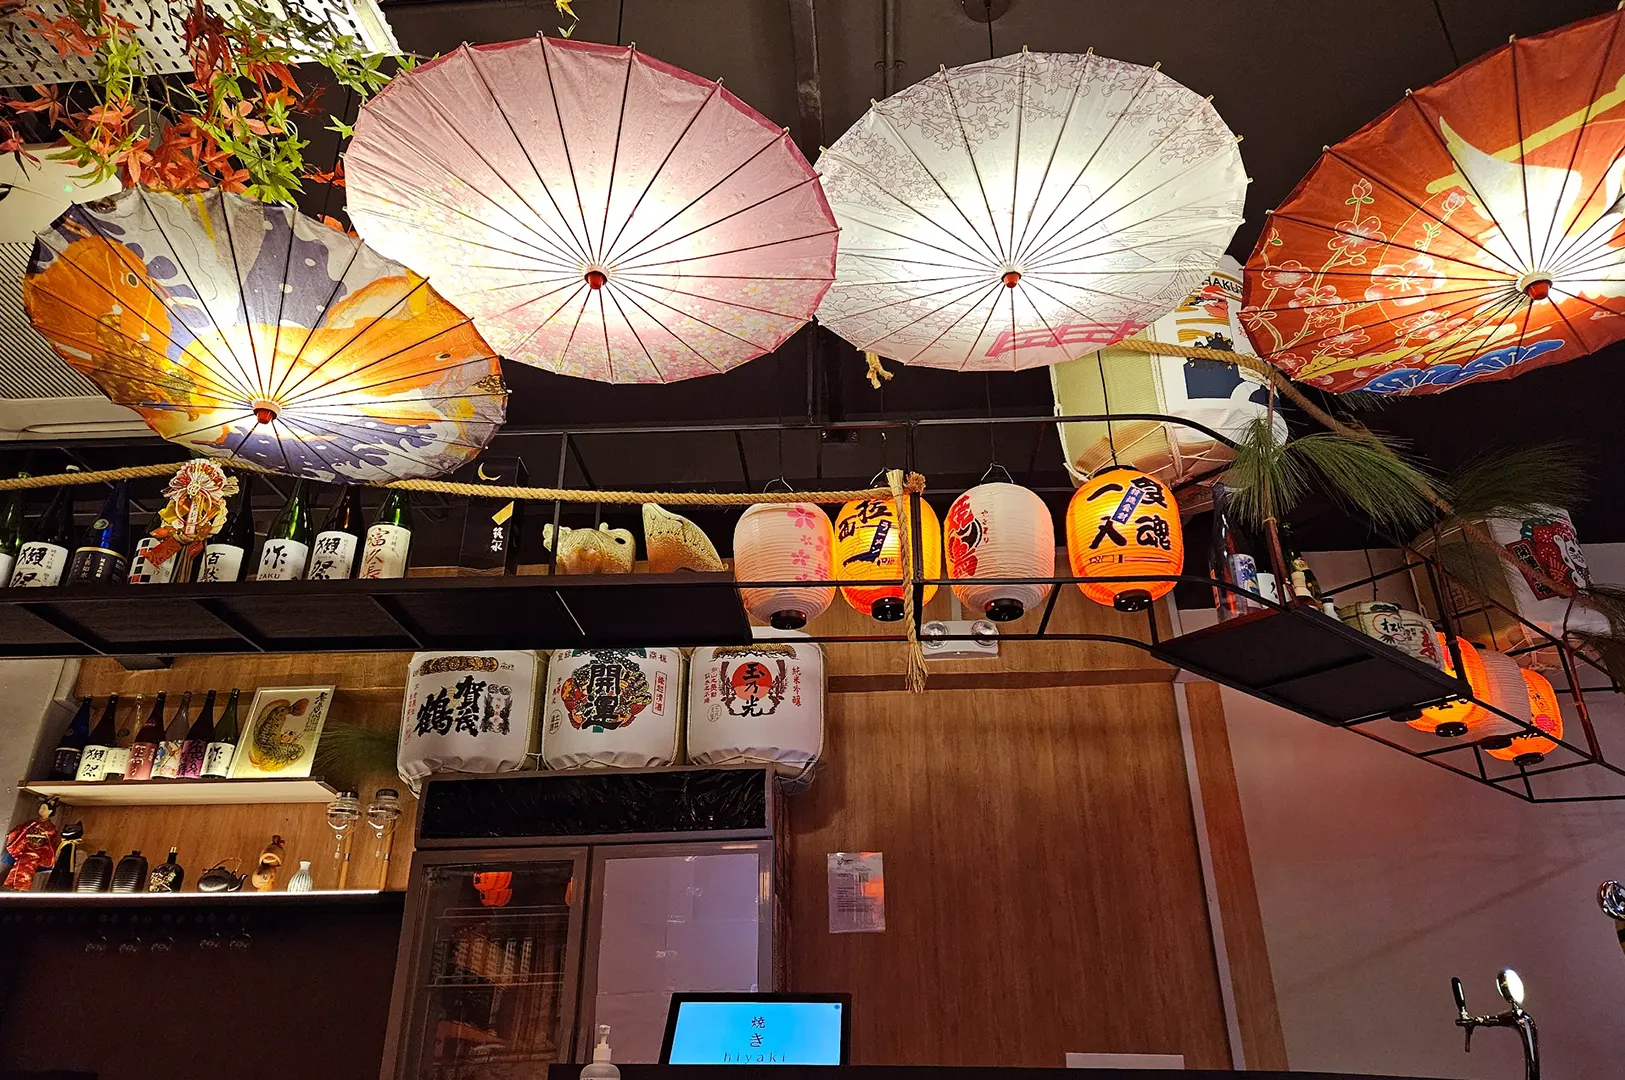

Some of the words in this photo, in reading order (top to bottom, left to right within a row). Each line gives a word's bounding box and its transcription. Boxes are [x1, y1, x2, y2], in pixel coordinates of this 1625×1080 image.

[263, 545, 288, 569] 作
[309, 537, 342, 580] 獺祭
[362, 527, 391, 580] 富久長
[872, 521, 889, 554] ラーメン
[413, 675, 487, 737] 賀茂鶴
[581, 664, 622, 730] 開運
[742, 662, 766, 718] 玉乃光
[791, 665, 802, 708] 純米吟醸
[750, 1016, 767, 1048] 焼き
[723, 1051, 787, 1065] hiyaki
